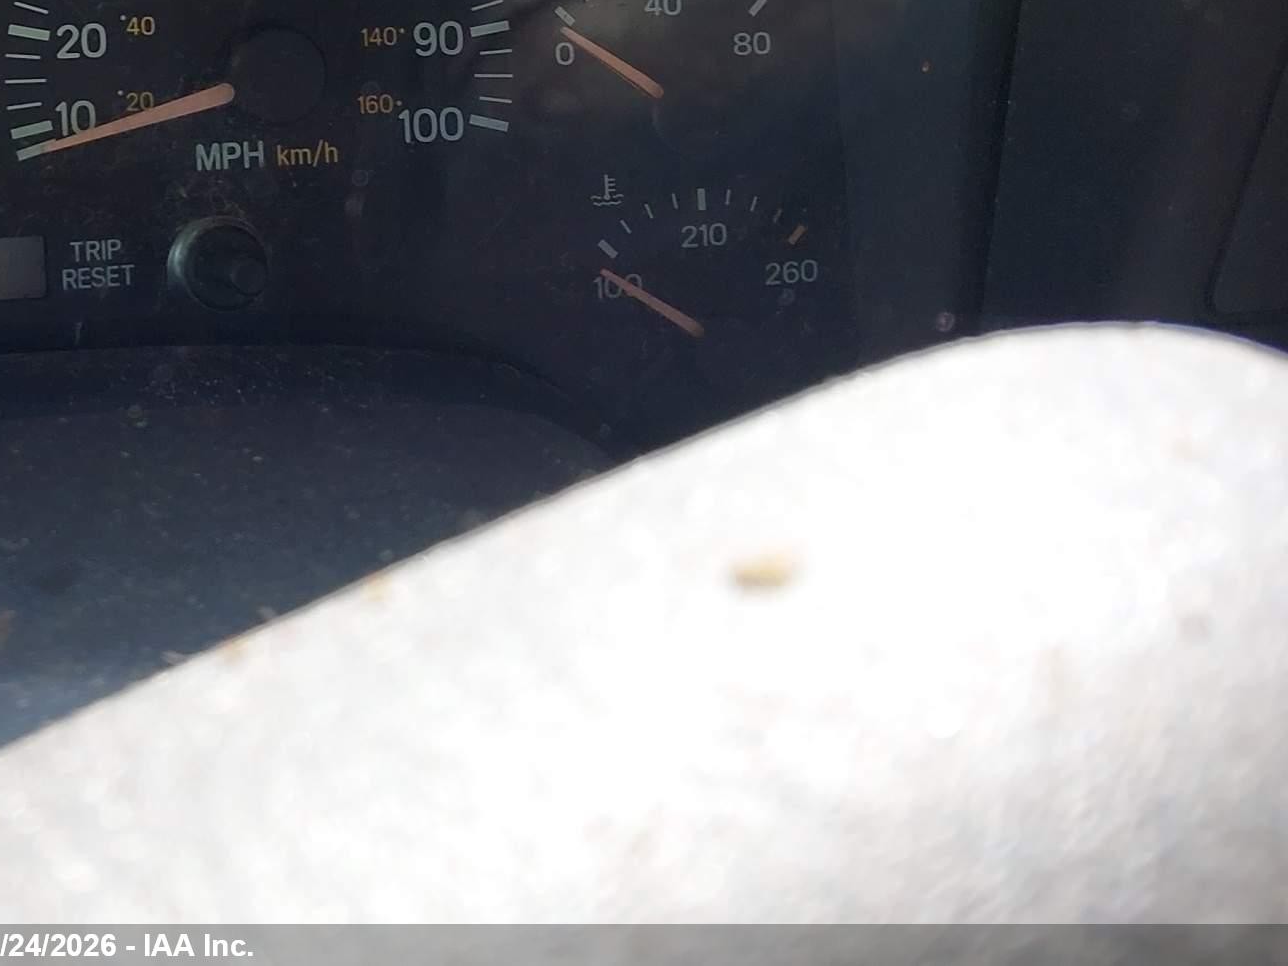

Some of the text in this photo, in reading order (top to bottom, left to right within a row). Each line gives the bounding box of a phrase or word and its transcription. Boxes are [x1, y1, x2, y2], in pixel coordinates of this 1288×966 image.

[126, 16, 155, 36] 40
[360, 27, 398, 46] 140
[56, 23, 107, 59] 20
[413, 21, 463, 56] 90
[733, 32, 771, 56] 80
[555, 42, 575, 65] 0
[126, 92, 154, 112] 20
[358, 95, 394, 114] 160
[55, 100, 96, 137] 10
[398, 107, 464, 144] 100
[195, 140, 338, 171] MPH km/h
[681, 223, 727, 247] 210
[70, 239, 122, 262] TRIP
[63, 264, 134, 289] RESET
[765, 259, 818, 285] 260
